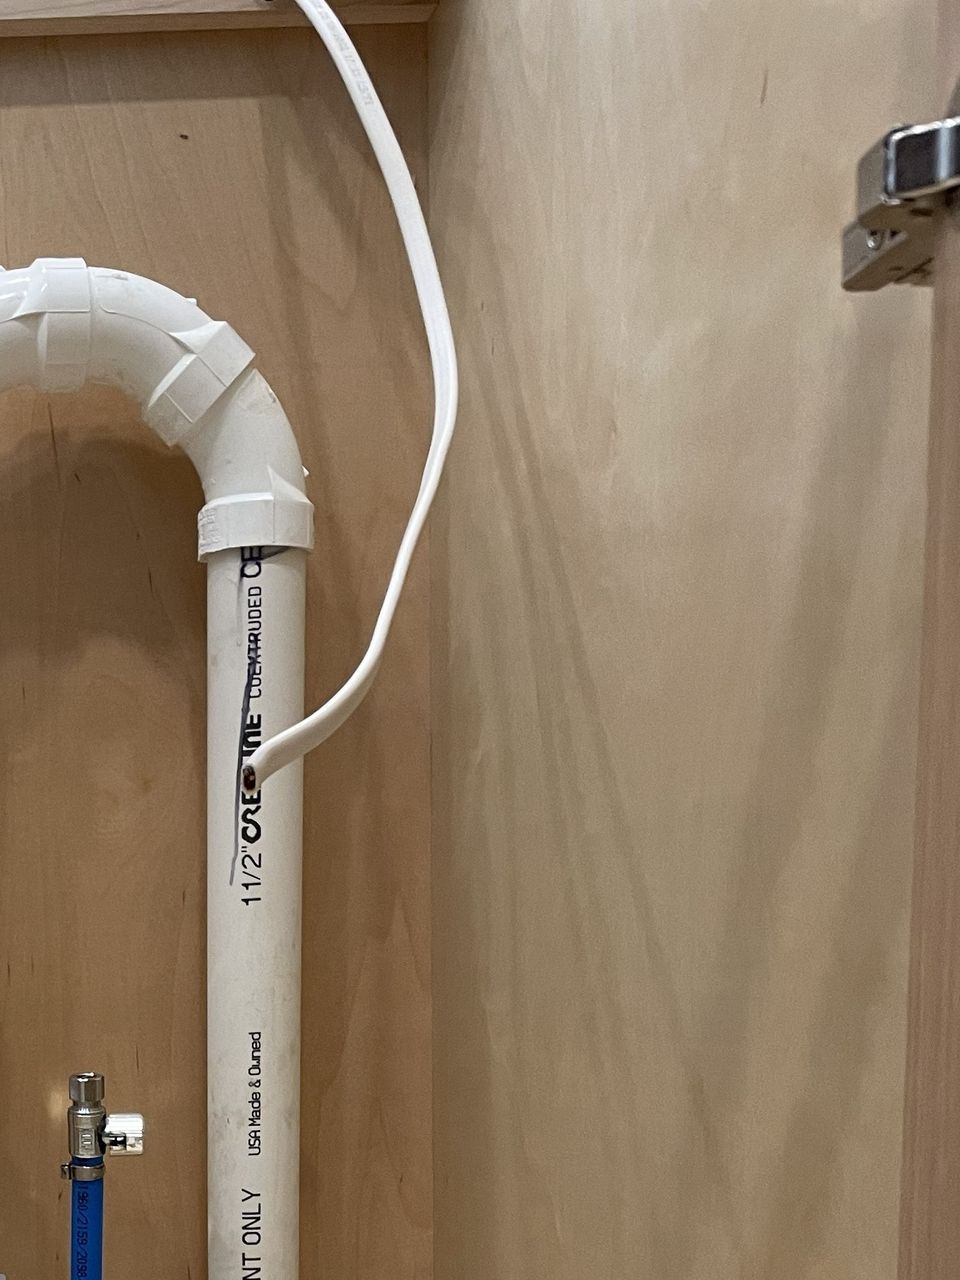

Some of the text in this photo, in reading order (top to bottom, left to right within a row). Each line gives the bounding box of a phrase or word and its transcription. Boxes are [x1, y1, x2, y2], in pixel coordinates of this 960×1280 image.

[247, 586, 262, 698] COEXTRUDED
[247, 1031, 261, 1156] USA Made & Owned
[241, 1188, 262, 1246] ONLY
